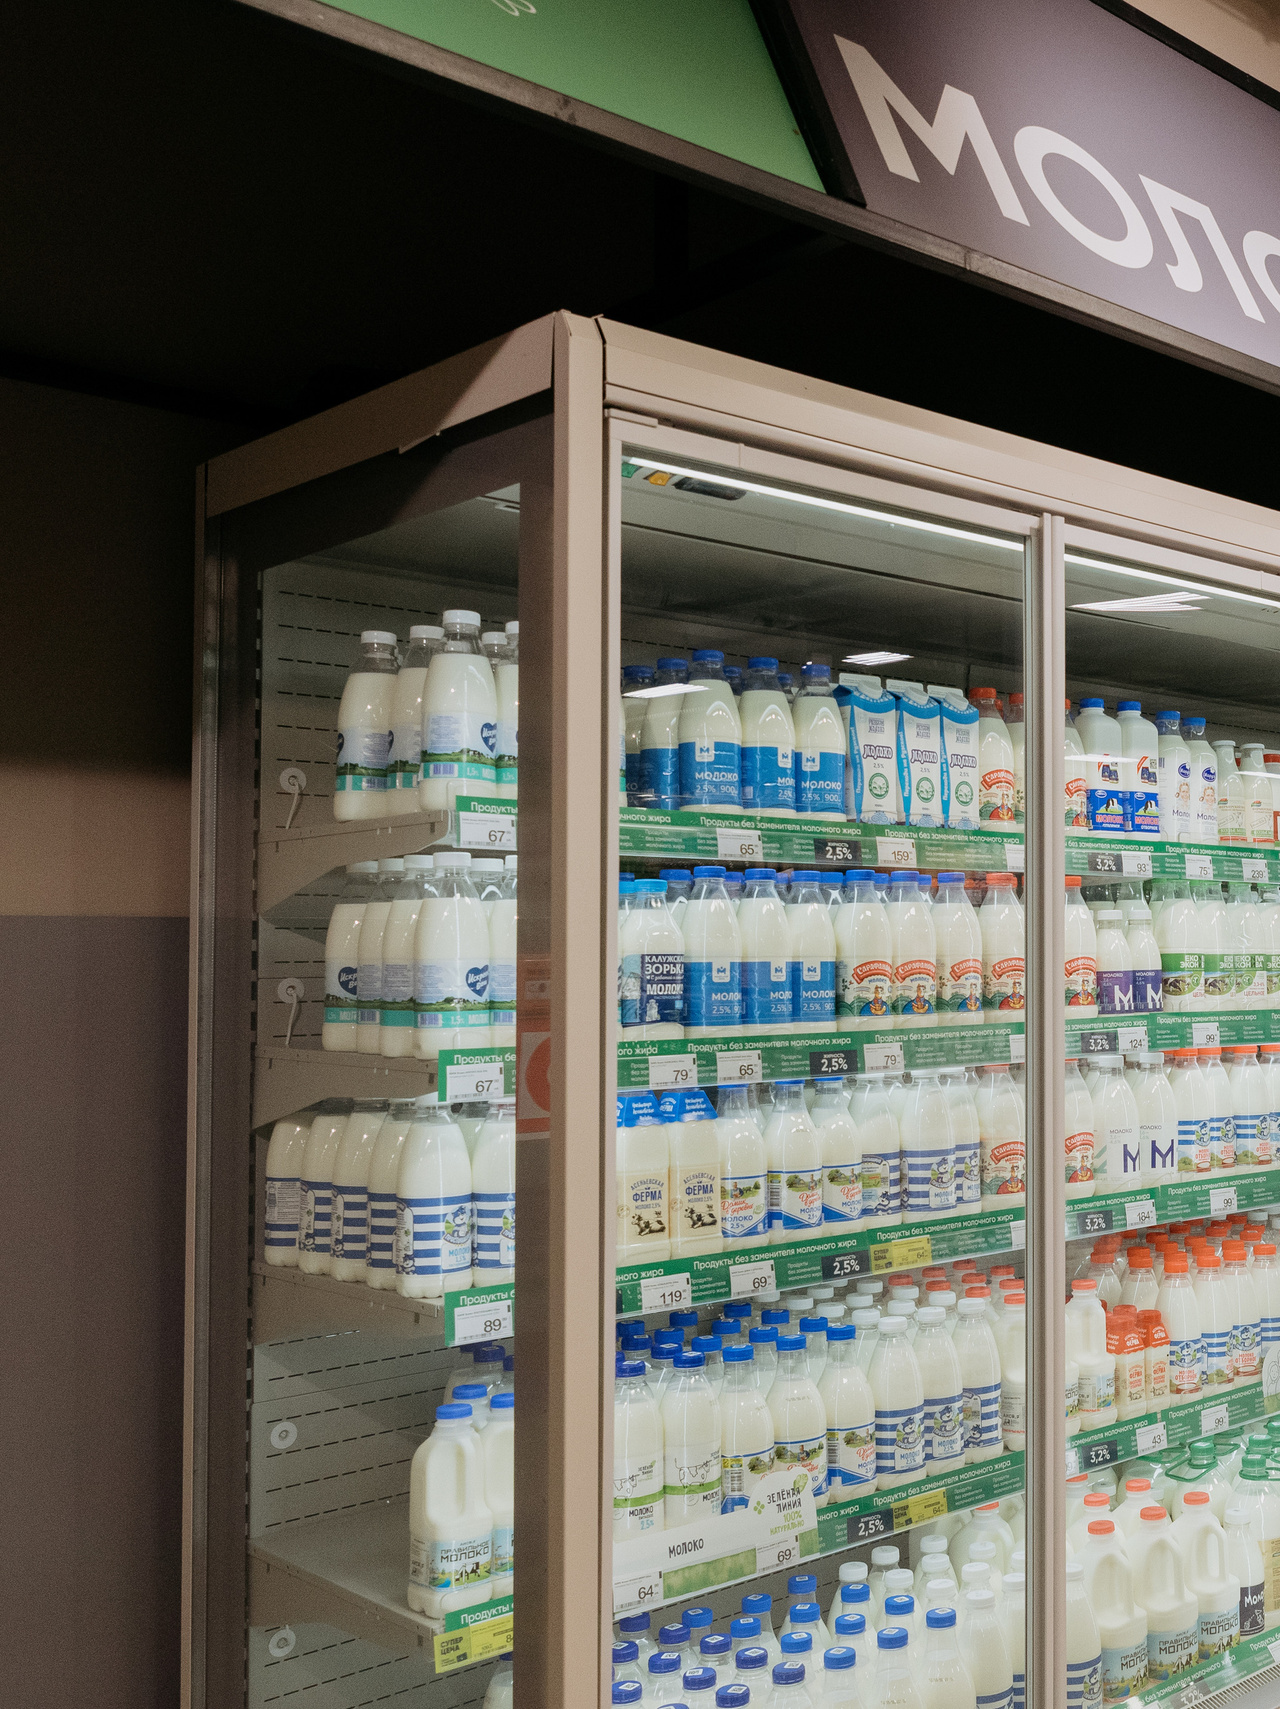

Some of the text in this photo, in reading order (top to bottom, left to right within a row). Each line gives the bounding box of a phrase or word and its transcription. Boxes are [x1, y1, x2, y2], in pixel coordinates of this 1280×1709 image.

[696, 772, 738, 781] МОЛОКО
[802, 781, 841, 790] МОЛОКО
[471, 801, 518, 814] Продукты
[700, 817, 739, 828] Продукты
[741, 819, 755, 828] без
[757, 821, 800, 831] заменителя
[842, 828, 861, 836] жира
[488, 830, 505, 842] 67
[885, 829, 918, 839] Продукты
[932, 833, 968, 841] заменителя
[969, 836, 1002, 844] молочного
[740, 844, 754, 855] 65
[825, 847, 852, 860] 2,5%
[892, 851, 909, 862] 159
[1096, 859, 1116, 871] 3,2%
[1136, 863, 1146, 872] 93
[1199, 867, 1208, 875] 75
[1251, 870, 1263, 878] 239
[712, 1006, 731, 1014] 2,5%
[771, 1004, 787, 1012] 2,5%
[803, 1003, 821, 1011] 2,5%
[875, 1034, 908, 1043] Продукты
[922, 1032, 959, 1040] заменителя
[960, 1030, 993, 1038] молочного
[994, 1028, 1011, 1036] жира
[1206, 1034, 1215, 1043] 99
[687, 1037, 851, 1053] Продукты без заменителя молочного жира
[1089, 1040, 1109, 1052] 3,2%
[1129, 1039, 1143, 1048] 124
[635, 1046, 658, 1055] жира
[454, 1053, 502, 1065] Продукты
[821, 1058, 848, 1071] 2,5%
[884, 1055, 897, 1065] 79
[673, 1069, 688, 1082] 79
[739, 1064, 754, 1076] 65
[475, 1080, 493, 1093] 67
[632, 1190, 663, 1202] ФЕРМА
[685, 1184, 714, 1196] ФЕРМА
[1106, 1195, 1135, 1205] молочного
[1136, 1194, 1150, 1202] жира
[1223, 1198, 1232, 1208] 99
[721, 1214, 753, 1223] МОЛОКО
[1137, 1211, 1150, 1222] 184
[877, 1213, 1014, 1241] Продукты без заменителя молочного жира
[1085, 1218, 1106, 1231] 3,2%
[694, 1238, 857, 1270] Продукты без заменителя молочного жира
[640, 1268, 664, 1278] жира
[833, 1259, 860, 1275] 2,5%
[753, 1276, 767, 1289] 69
[460, 1292, 508, 1306] Продукты
[660, 1290, 682, 1305] 119
[484, 1319, 501, 1332] 89
[1169, 1408, 1194, 1419] Продукты
[1195, 1404, 1203, 1412] без
[1215, 1417, 1224, 1427] 99
[1104, 1425, 1133, 1437] молочного
[1134, 1420, 1148, 1429] жира
[1152, 1435, 1161, 1445] 43
[1090, 1449, 1110, 1463] 3,2%
[874, 1492, 907, 1506] Продукты
[908, 1487, 920, 1496] без
[921, 1476, 959, 1493] заменителя
[960, 1467, 993, 1483] молочного
[994, 1460, 1011, 1470] жира
[767, 1486, 800, 1504] ЗЕЛЁНАЯ
[629, 1506, 653, 1517] МОЛОКО
[776, 1498, 802, 1513] ЛИНИЯ
[839, 1504, 859, 1515] жира
[894, 1504, 909, 1514] СУПЕР
[933, 1506, 941, 1514] 64
[783, 1510, 802, 1521] 100%
[894, 1510, 908, 1519] ЦЕНА
[770, 1520, 804, 1535] НАТУРАЛЬНО
[858, 1519, 885, 1536] 2,5%
[441, 1546, 489, 1562] МОЛОКО
[668, 1538, 704, 1558] МОЛОКО
[777, 1548, 792, 1563] 69
[638, 1585, 654, 1599] 64
[461, 1603, 509, 1624] Продукты
[1201, 1618, 1240, 1635] МОЛОКО
[441, 1637, 463, 1647] СУПЕР
[441, 1645, 459, 1655] ЦЕНА
